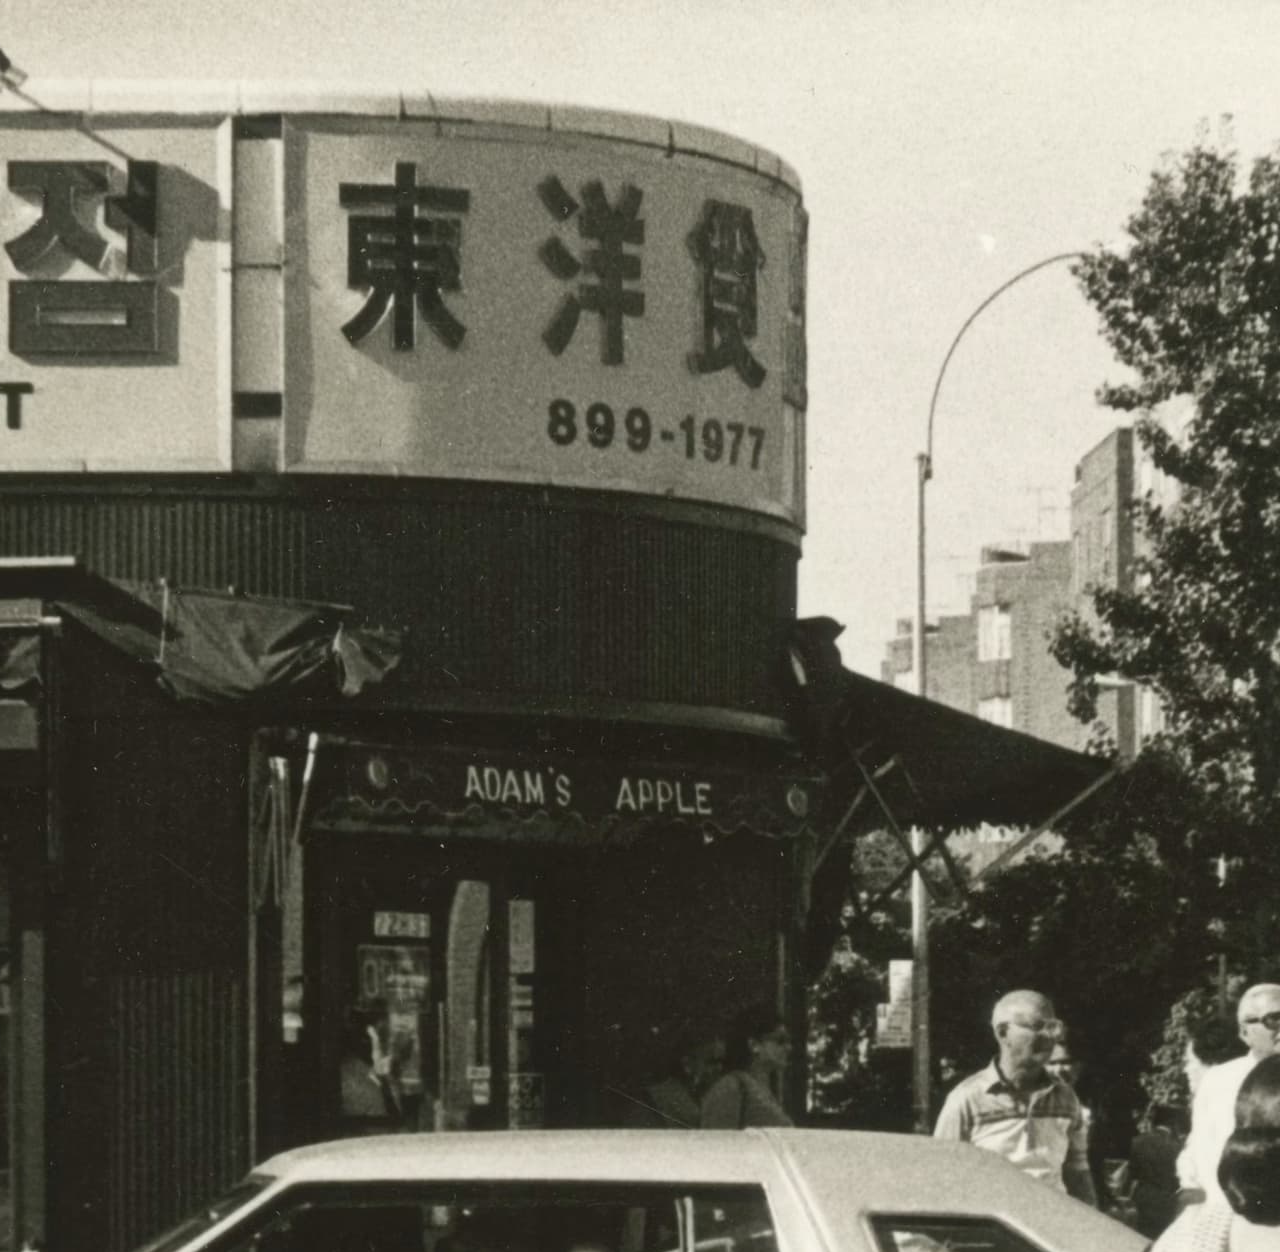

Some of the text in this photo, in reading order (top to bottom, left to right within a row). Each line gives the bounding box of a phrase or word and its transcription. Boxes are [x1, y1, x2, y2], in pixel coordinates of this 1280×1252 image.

[546, 399, 766, 470] 899-1977
[464, 765, 712, 815] ADAM'S APPLE
